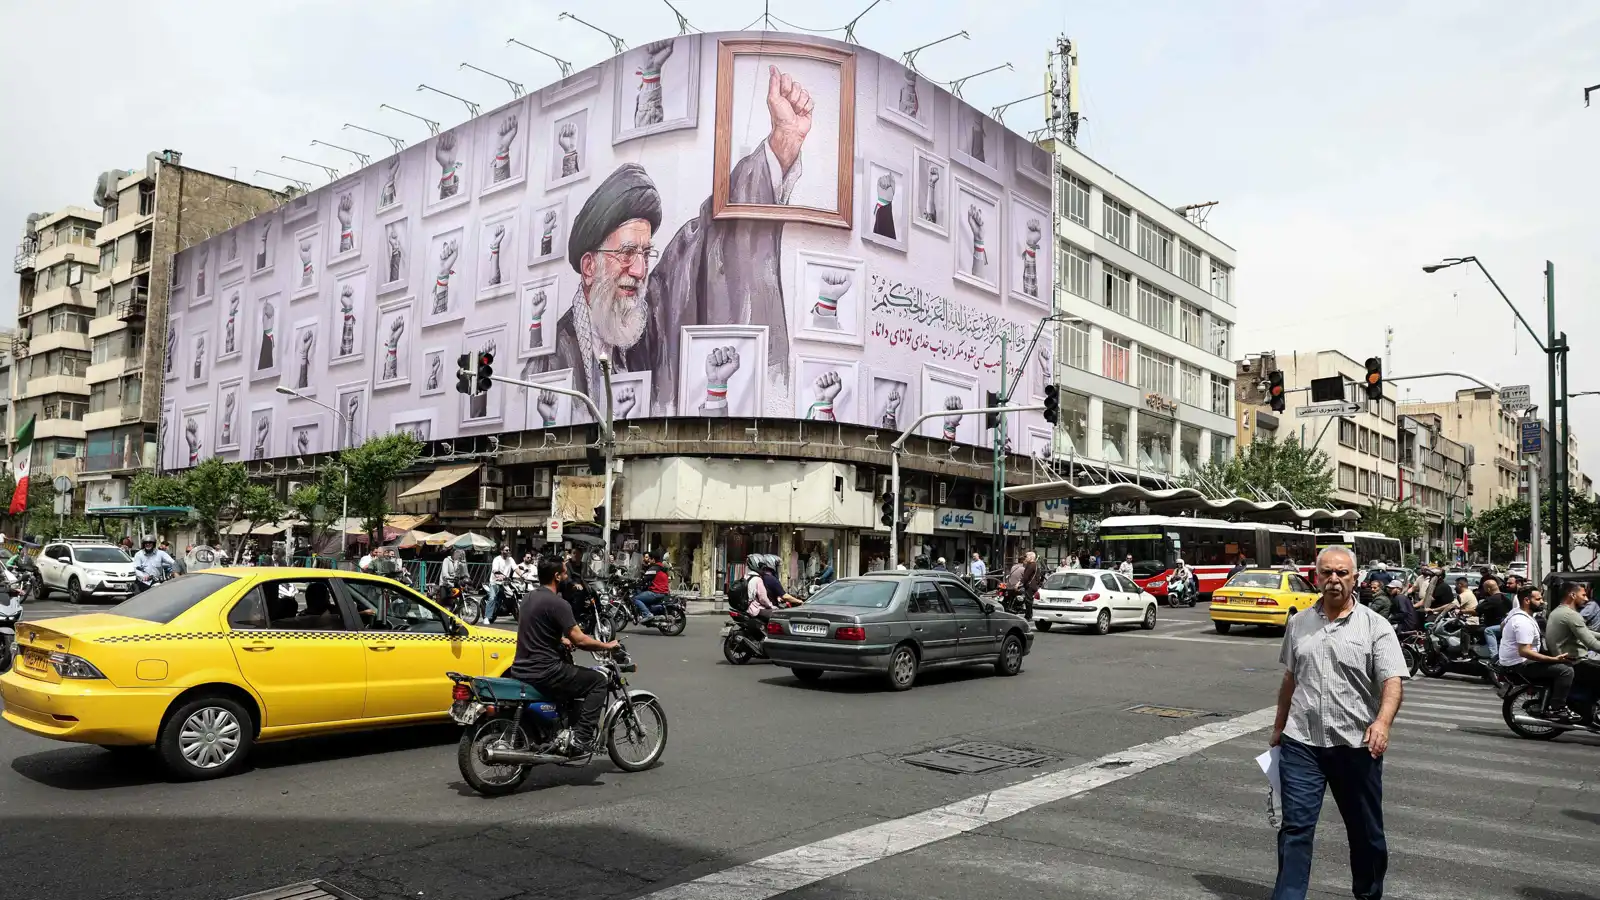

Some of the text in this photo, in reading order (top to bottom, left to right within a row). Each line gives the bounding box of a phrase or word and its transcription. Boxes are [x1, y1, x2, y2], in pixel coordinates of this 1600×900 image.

[889, 328, 913, 346] توانای
[911, 333, 930, 351] خدای
[930, 340, 948, 360] جانب
[1299, 408, 1318, 416] اسلامی
[941, 510, 974, 528] کوه نور
